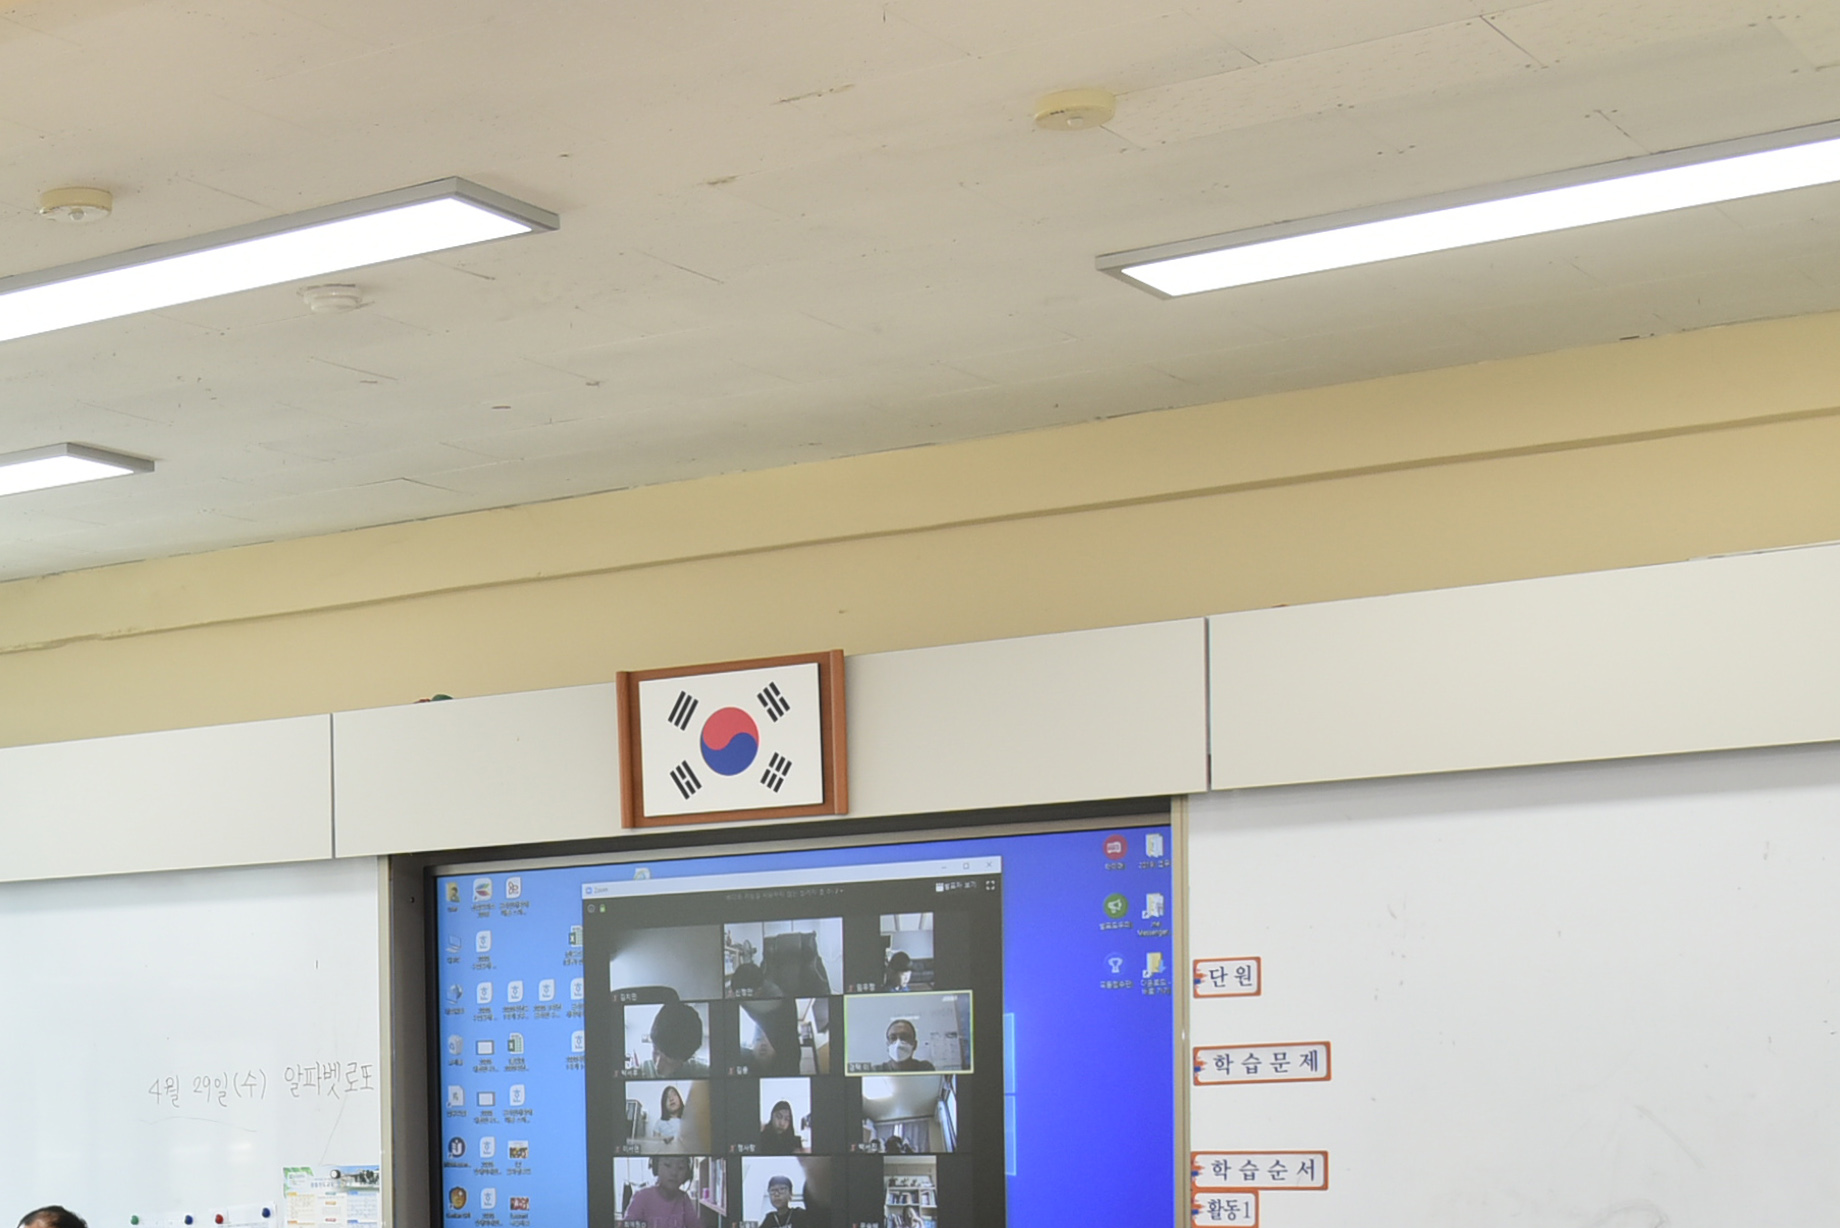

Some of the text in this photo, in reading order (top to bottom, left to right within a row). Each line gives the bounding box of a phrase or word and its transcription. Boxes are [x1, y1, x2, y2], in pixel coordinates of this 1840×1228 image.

[1209, 964, 1254, 988] 단원
[1213, 1049, 1319, 1076] 학습문제
[148, 1074, 180, 1108] 4월
[192, 1069, 267, 1108] 29일(수)
[1211, 1157, 1316, 1182] 학습순서
[1206, 1199, 1252, 1221] 활동1
